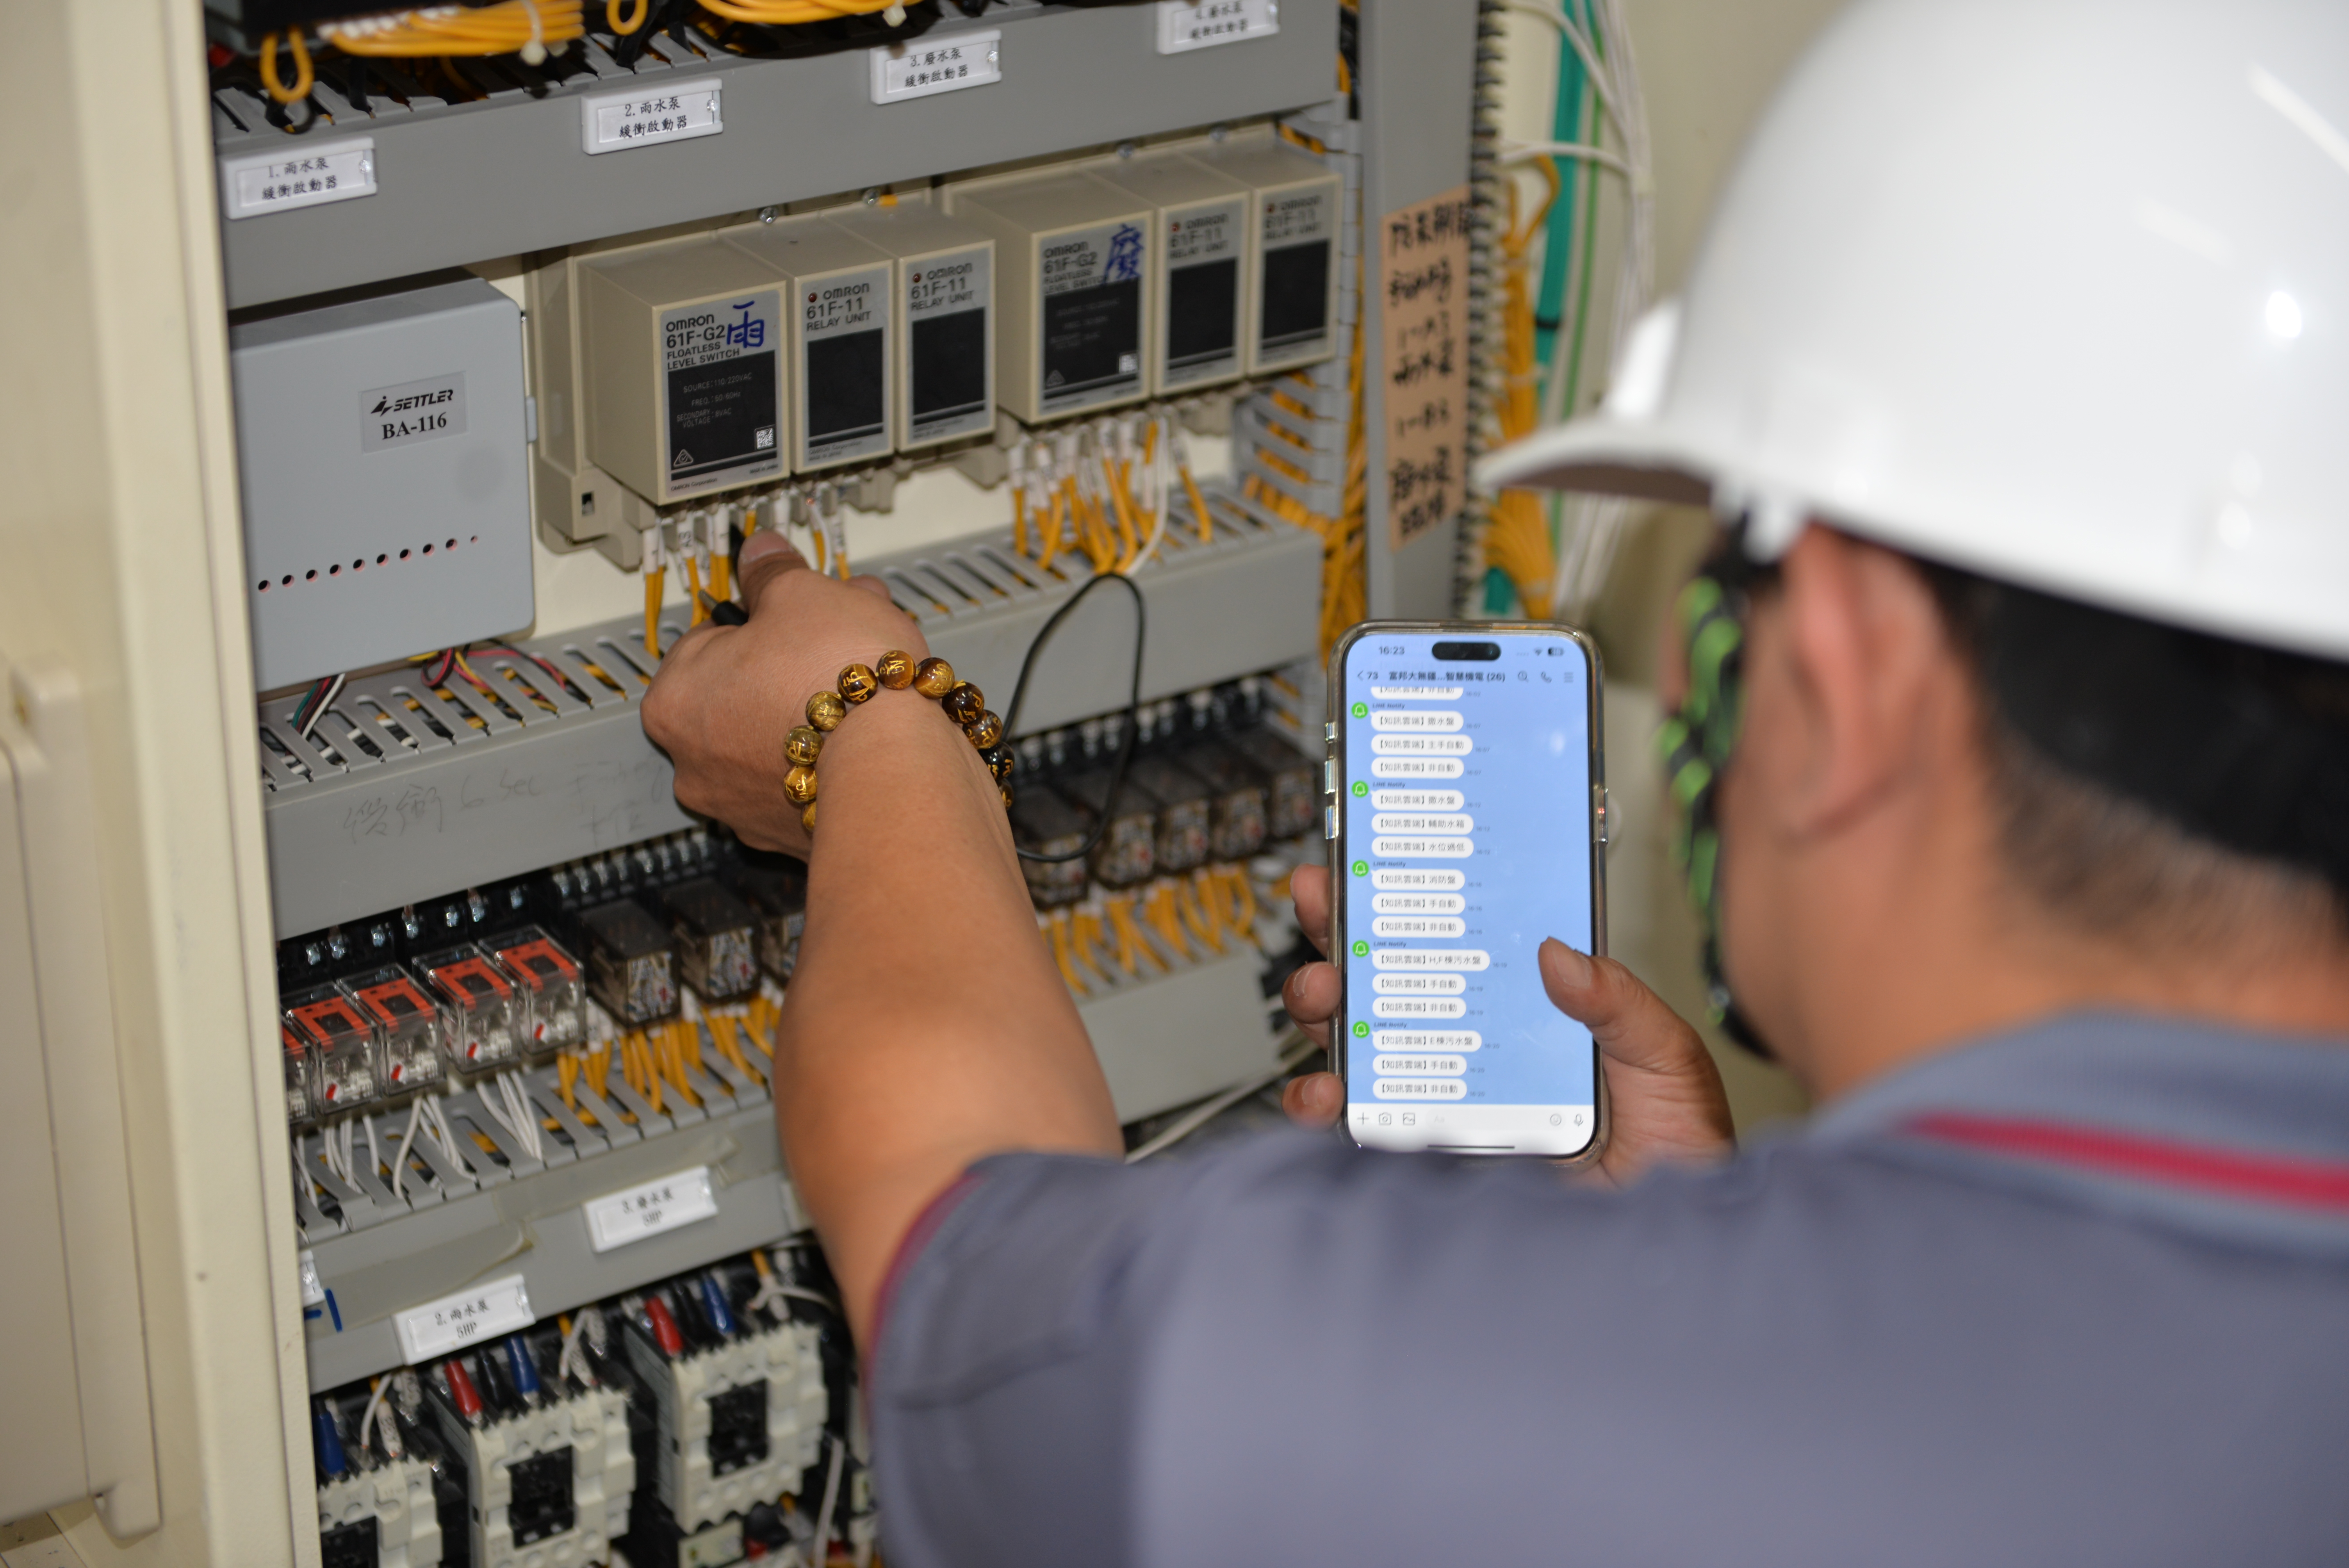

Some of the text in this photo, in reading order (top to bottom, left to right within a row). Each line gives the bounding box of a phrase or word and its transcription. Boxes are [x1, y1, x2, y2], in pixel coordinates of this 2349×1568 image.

[625, 96, 681, 117] 2.雨水泵
[619, 115, 687, 137] 緩衝啟動器
[262, 175, 337, 200] 緩衝啟動器
[1044, 241, 1088, 258] OMRON
[927, 263, 972, 281] OMRON
[1044, 251, 1097, 274] 61F-G2
[823, 283, 870, 300] OMRON
[911, 276, 966, 299] 61F-11
[807, 297, 863, 319] 61F-11
[911, 290, 974, 311] RELAY UNIT
[666, 314, 714, 332] OMRON
[727, 300, 764, 348] 雨
[807, 311, 872, 331] RELAY UNIT
[667, 325, 725, 348] 61F-G2
[667, 342, 720, 359] FLOATLESS
[668, 349, 739, 370] LEVEL SWITCH
[393, 389, 453, 412] SETTLER
[382, 412, 447, 440] BA-116
[683, 417, 711, 428] VOLTAGE
[671, 478, 718, 491] OMRON Corporation
[1379, 647, 1405, 655] 16:23
[1487, 672, 1505, 682] (26)
[456, 1322, 477, 1339] 5HP
